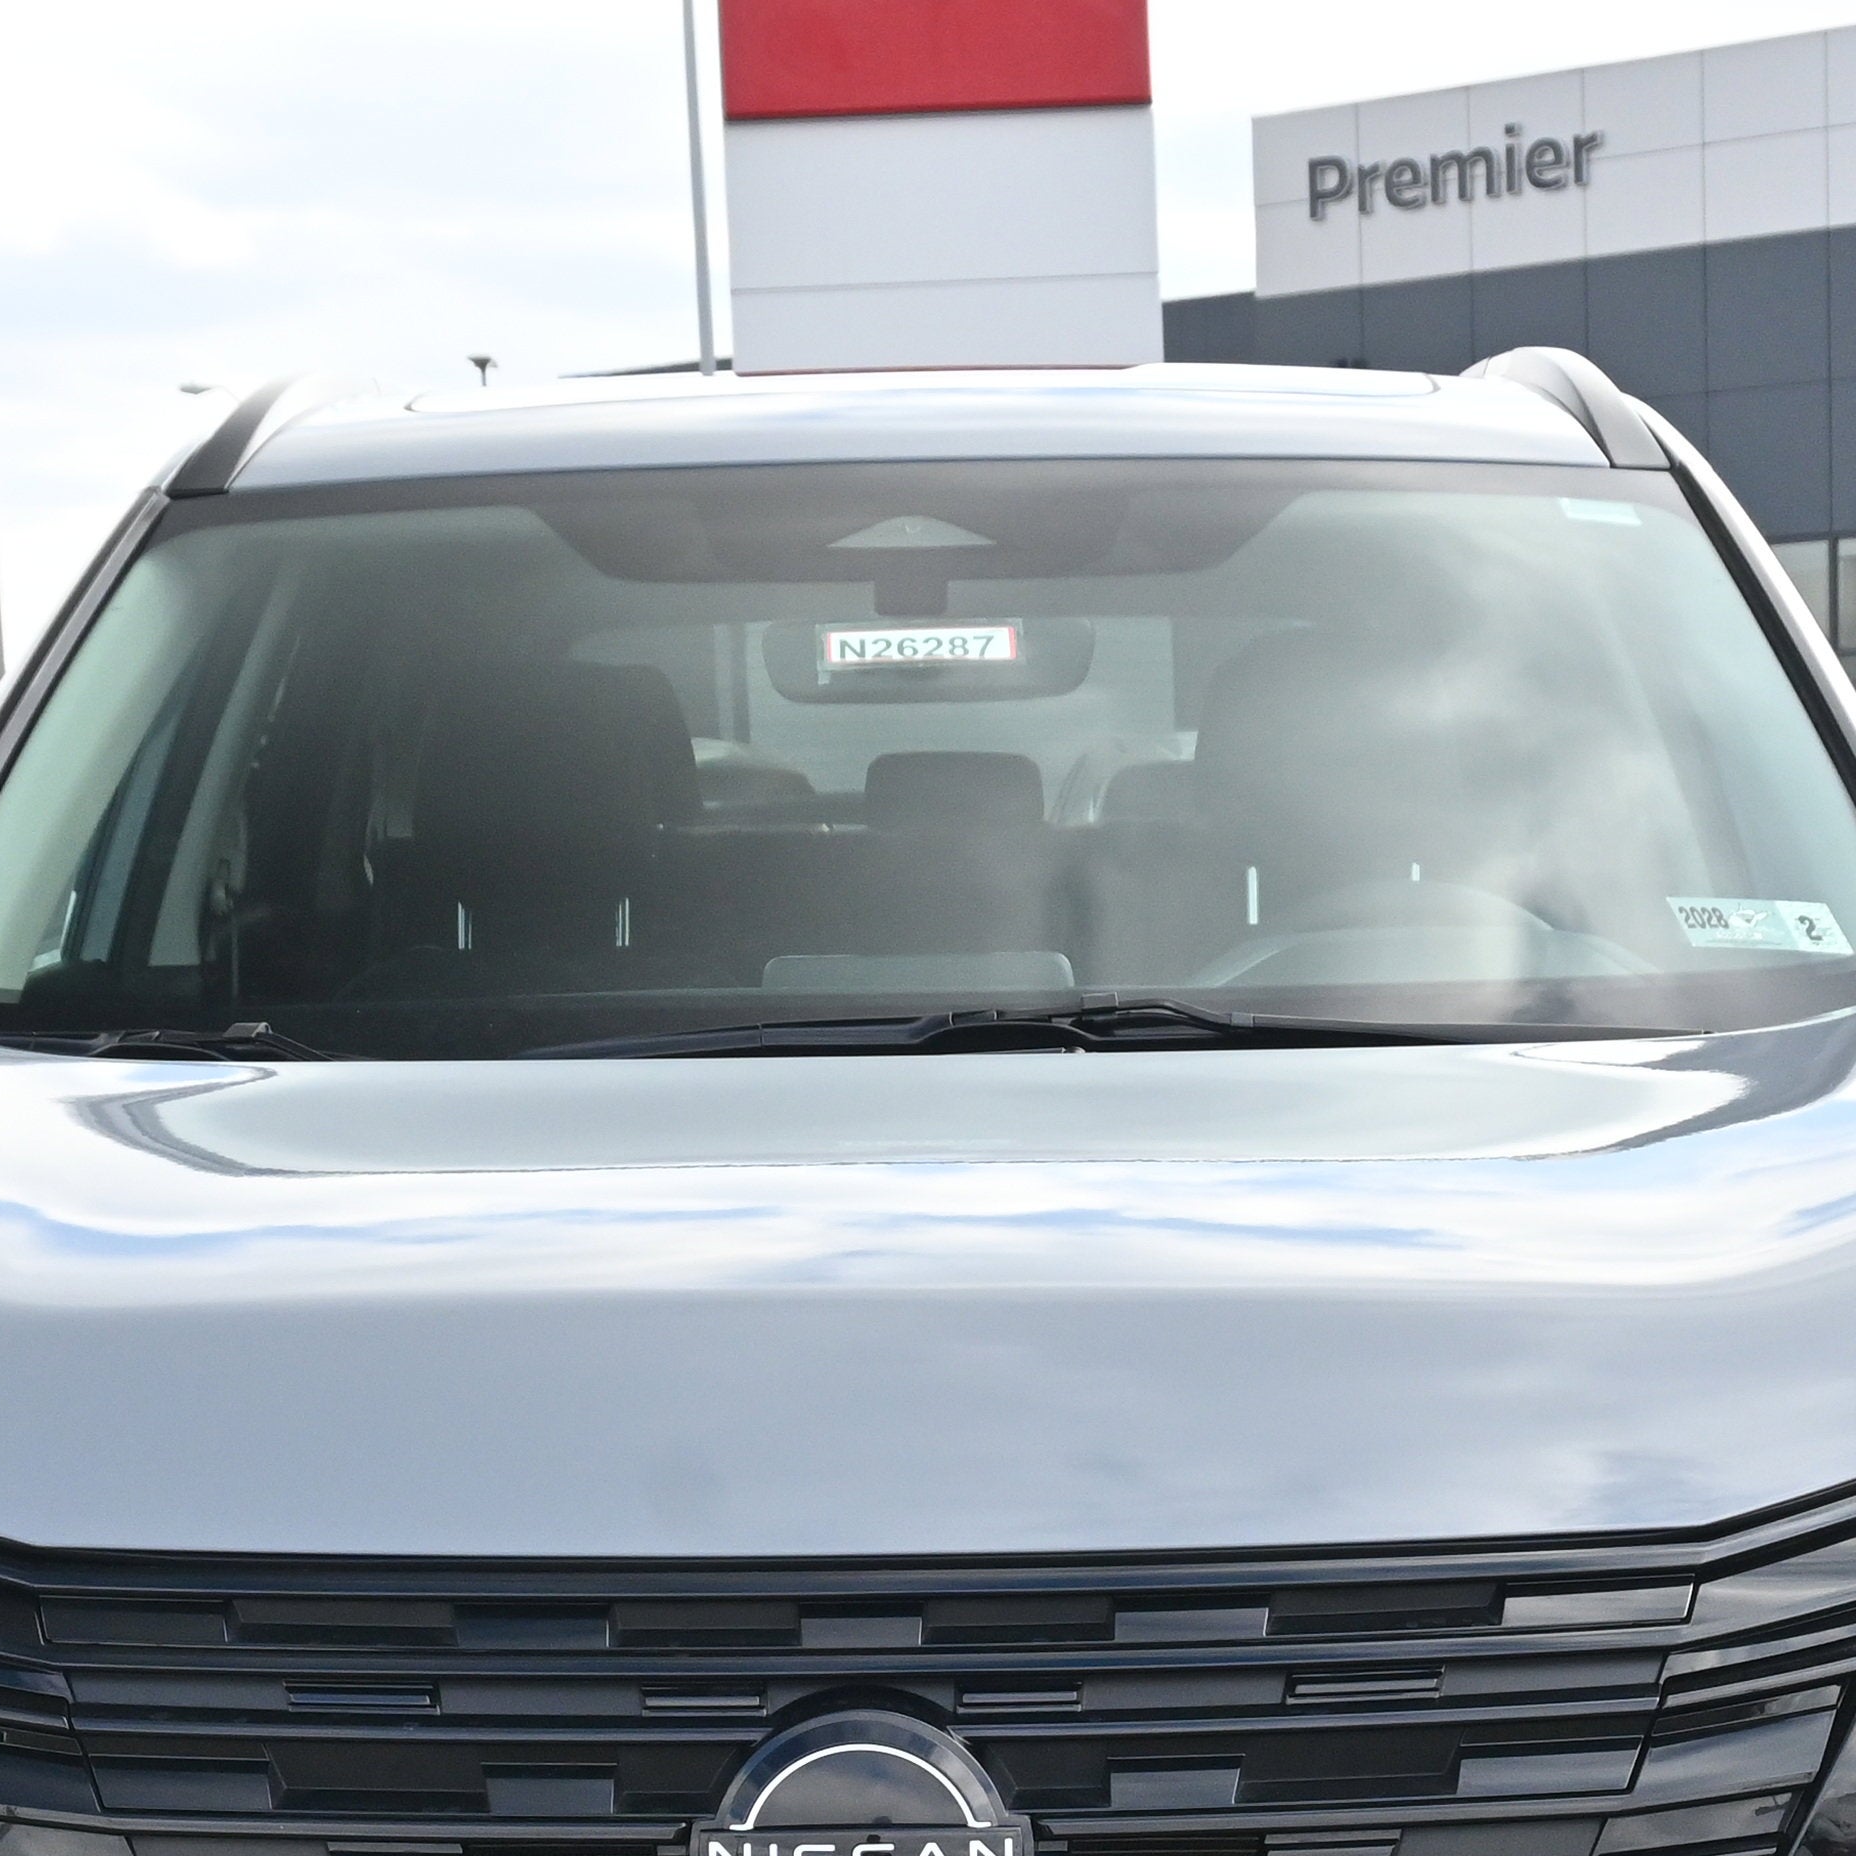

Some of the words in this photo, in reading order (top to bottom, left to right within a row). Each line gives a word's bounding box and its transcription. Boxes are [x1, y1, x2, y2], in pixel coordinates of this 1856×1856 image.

[1307, 121, 1603, 222] Premier
[838, 635, 995, 660] N26287
[1678, 906, 1729, 929] 2028
[1798, 915, 1823, 941] 2
